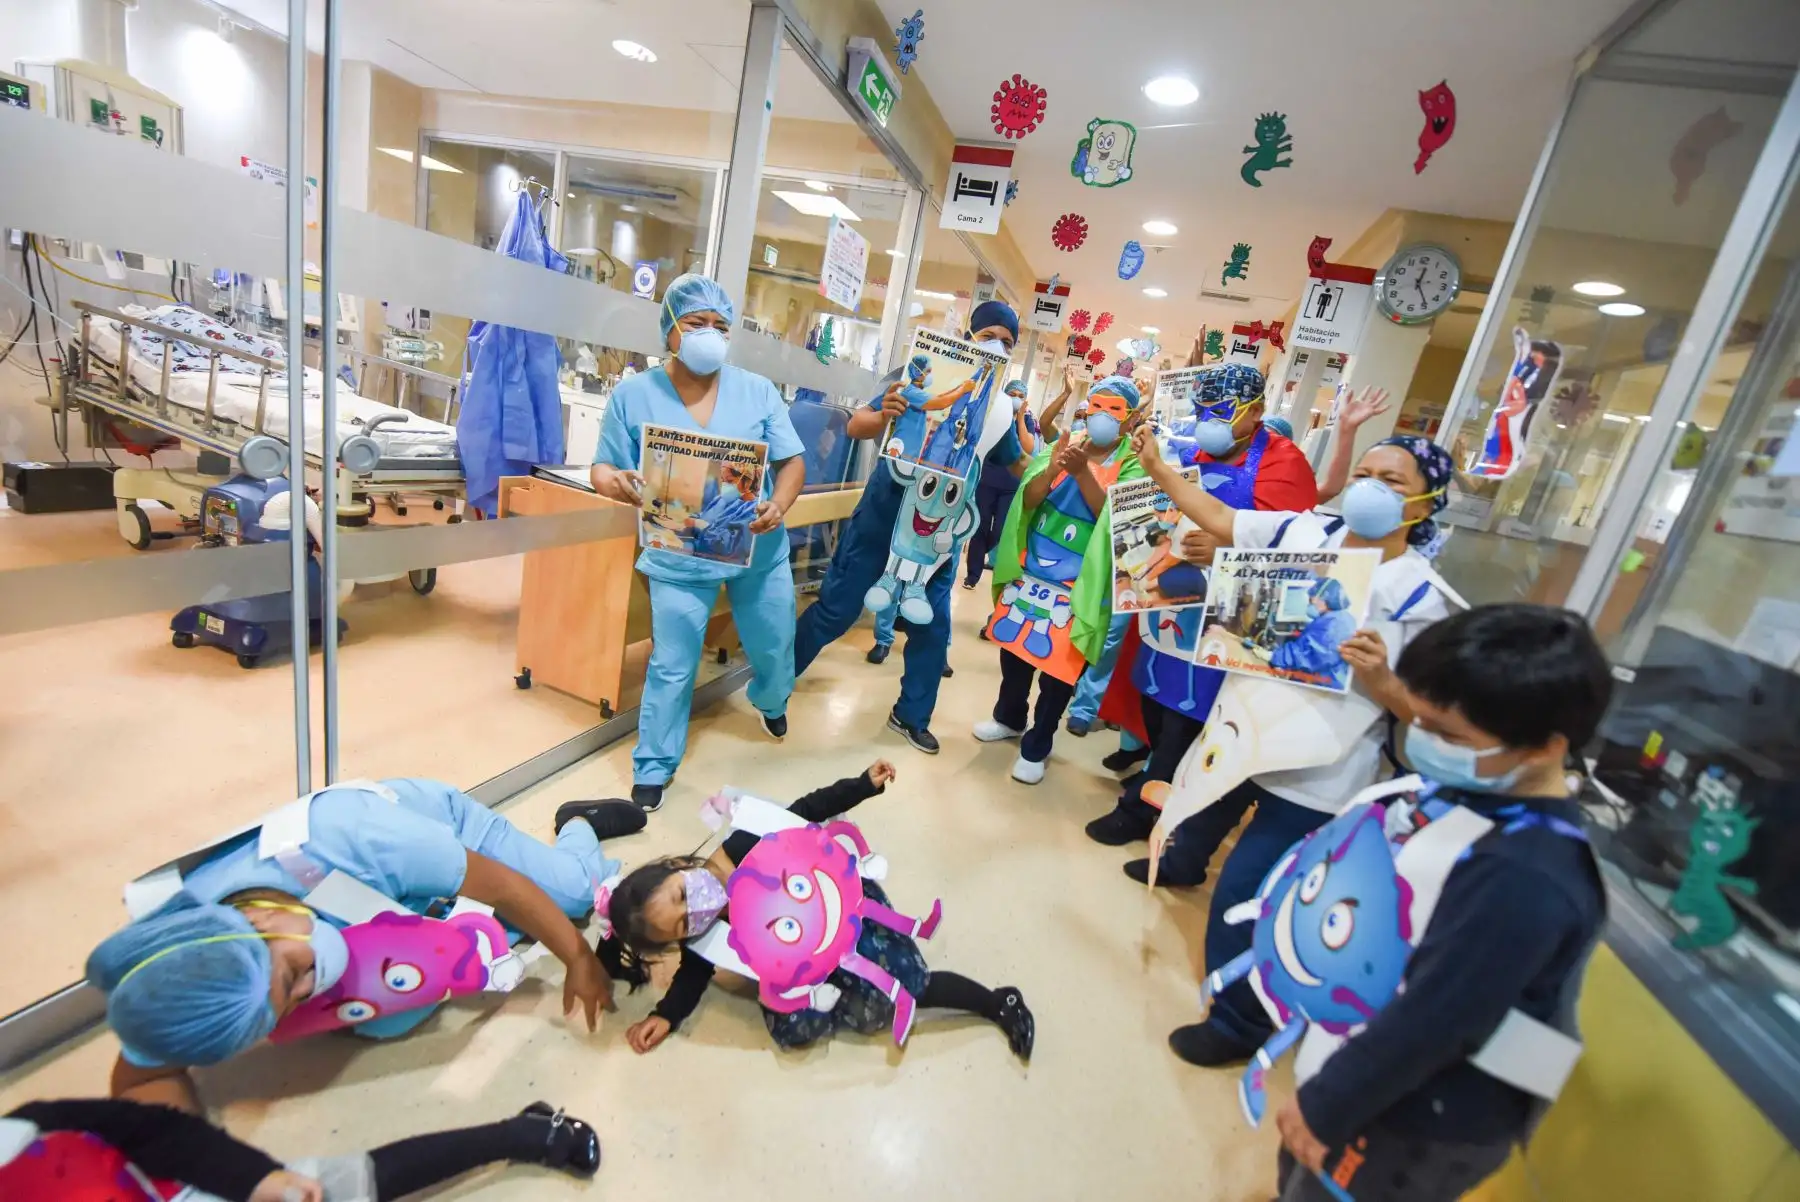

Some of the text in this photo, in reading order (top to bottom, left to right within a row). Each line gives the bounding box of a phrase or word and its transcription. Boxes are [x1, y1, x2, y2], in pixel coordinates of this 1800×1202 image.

[957, 214, 984, 224] Cama 2
[1407, 258, 1415, 267] 11
[1419, 256, 1431, 265] 12
[1434, 261, 1440, 269] 1
[1395, 267, 1406, 276] 10
[1440, 271, 1448, 279] 2
[1389, 278, 1397, 286] 9
[1440, 283, 1448, 291] 3
[1389, 290, 1398, 298] 8
[1432, 294, 1440, 302] 4
[1396, 300, 1404, 308] 7
[1407, 304, 1415, 312] 6
[1421, 302, 1428, 310] 5
[1299, 325, 1341, 338] Habitación
[1297, 333, 1326, 344] Aislado
[915, 340, 975, 366] CON EL PACIENTE.
[957, 343, 970, 353] DEL
[970, 347, 1008, 365] CONTACTO
[647, 428, 756, 453] 2. ANTES DE REALIZAR UNA
[647, 441, 692, 456] ACTIVIDAD
[1223, 551, 1339, 564] 1. ANTES DE TOCAR
[1233, 568, 1249, 578] AL
[1028, 583, 1051, 601] SG
